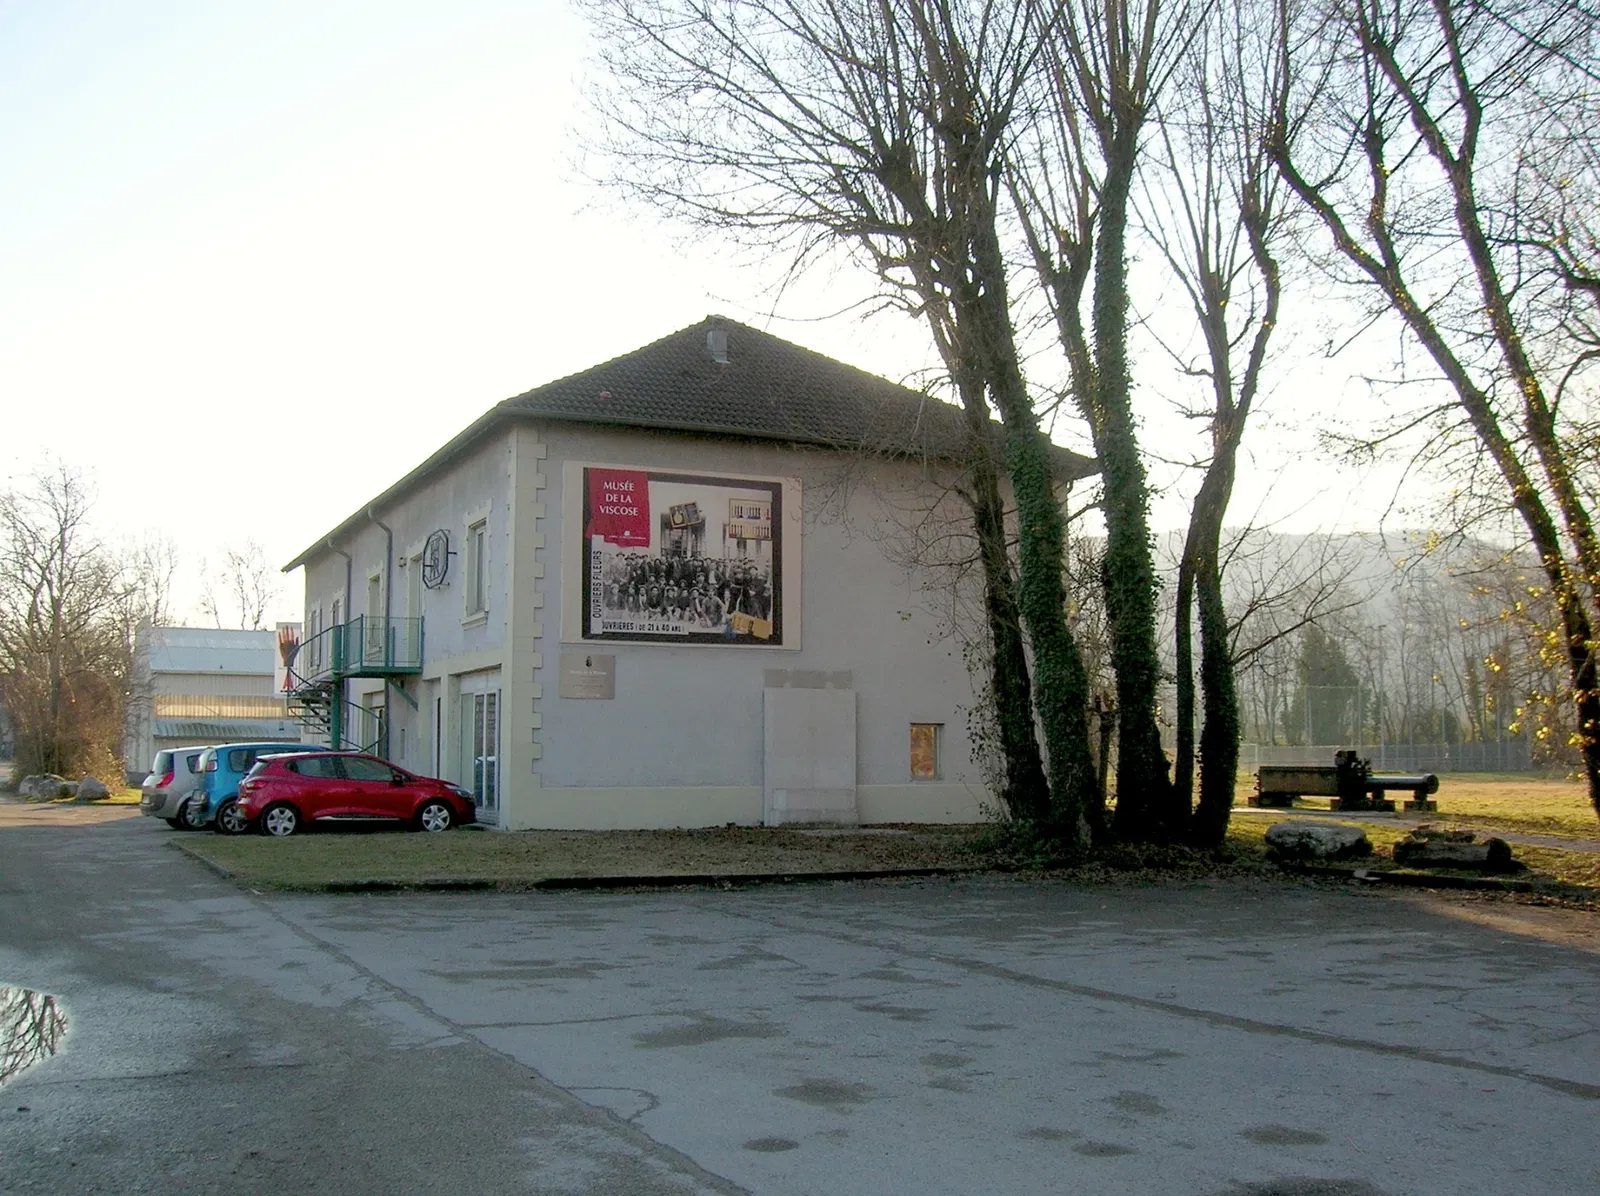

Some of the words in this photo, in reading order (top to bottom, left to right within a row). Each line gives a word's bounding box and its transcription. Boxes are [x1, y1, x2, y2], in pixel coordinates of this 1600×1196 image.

[603, 480, 635, 491] MUSÉE
[605, 493, 618, 502] DE
[620, 494, 632, 503] LA
[599, 505, 639, 516] VISCOSE
[592, 550, 602, 580] FILEURS
[592, 582, 602, 619] OUVRIERS
